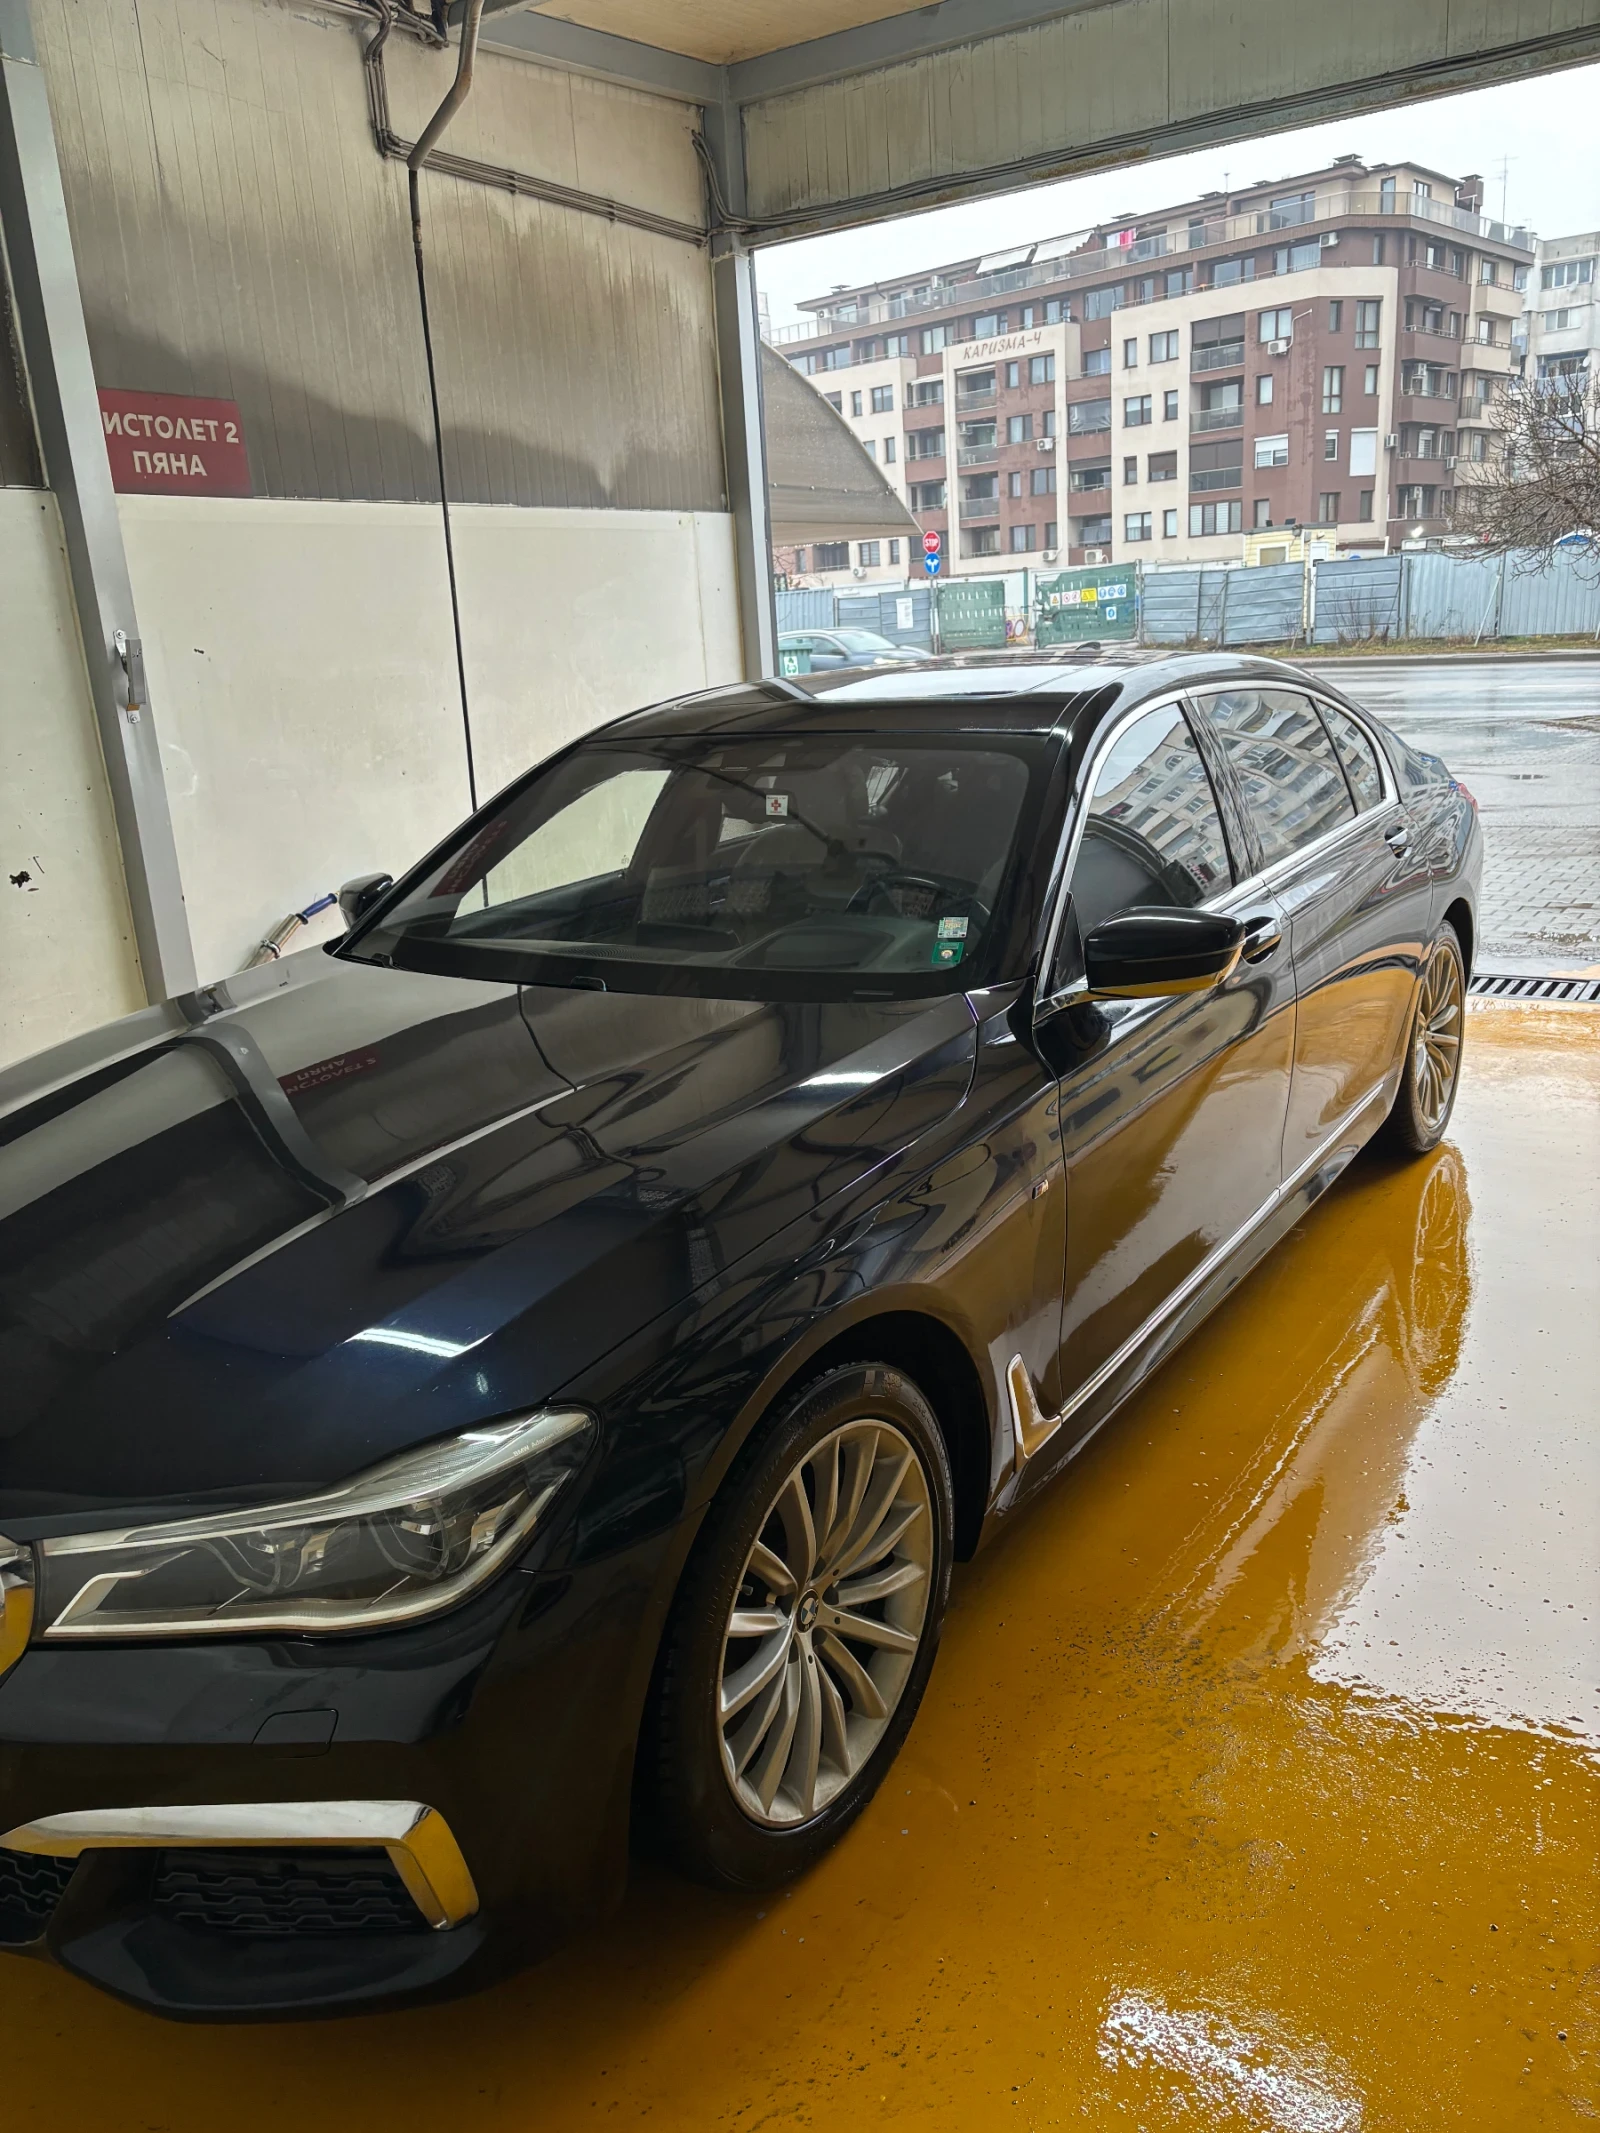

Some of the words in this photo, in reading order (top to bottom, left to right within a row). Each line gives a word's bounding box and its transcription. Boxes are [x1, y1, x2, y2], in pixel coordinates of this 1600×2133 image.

[224, 421, 240, 443] 2
[132, 450, 208, 477] ПЯНА
[924, 538, 939, 547] STOP
[512, 1445, 530, 1457] BMW
